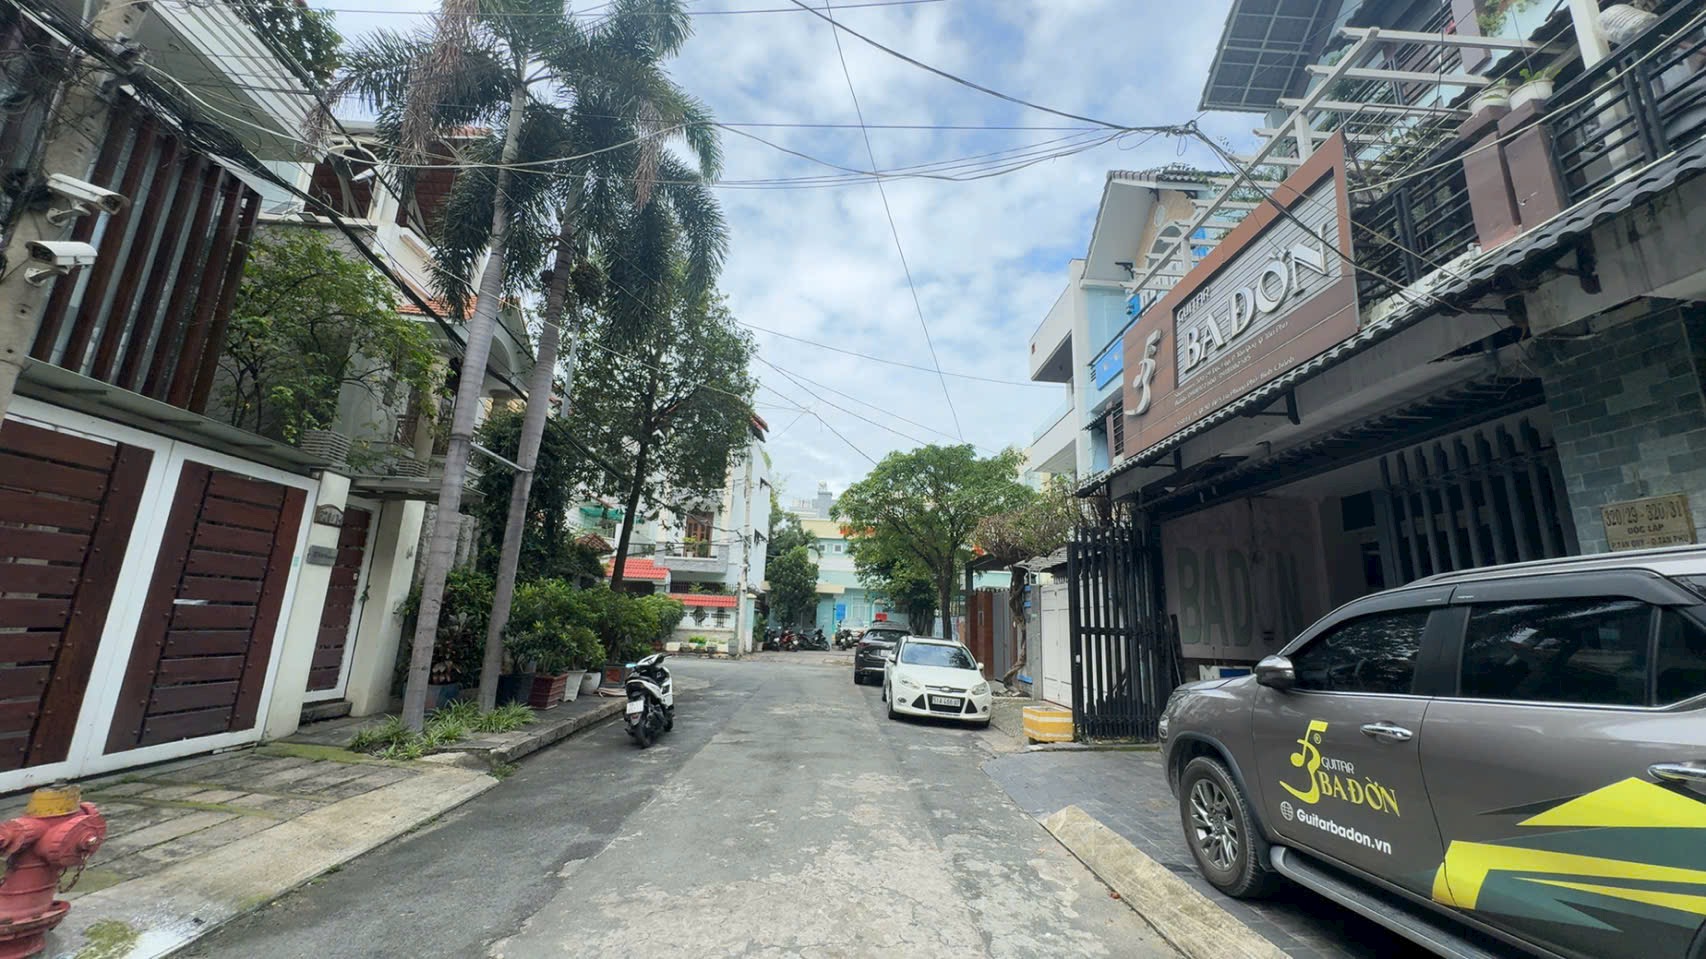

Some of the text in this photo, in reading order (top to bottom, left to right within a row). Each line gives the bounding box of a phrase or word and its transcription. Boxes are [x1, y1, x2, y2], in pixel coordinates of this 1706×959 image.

[1177, 286, 1210, 322] GUITAR
[1321, 756, 1355, 775] GUITAR
[1296, 808, 1392, 855] Guitarbadon.vn
